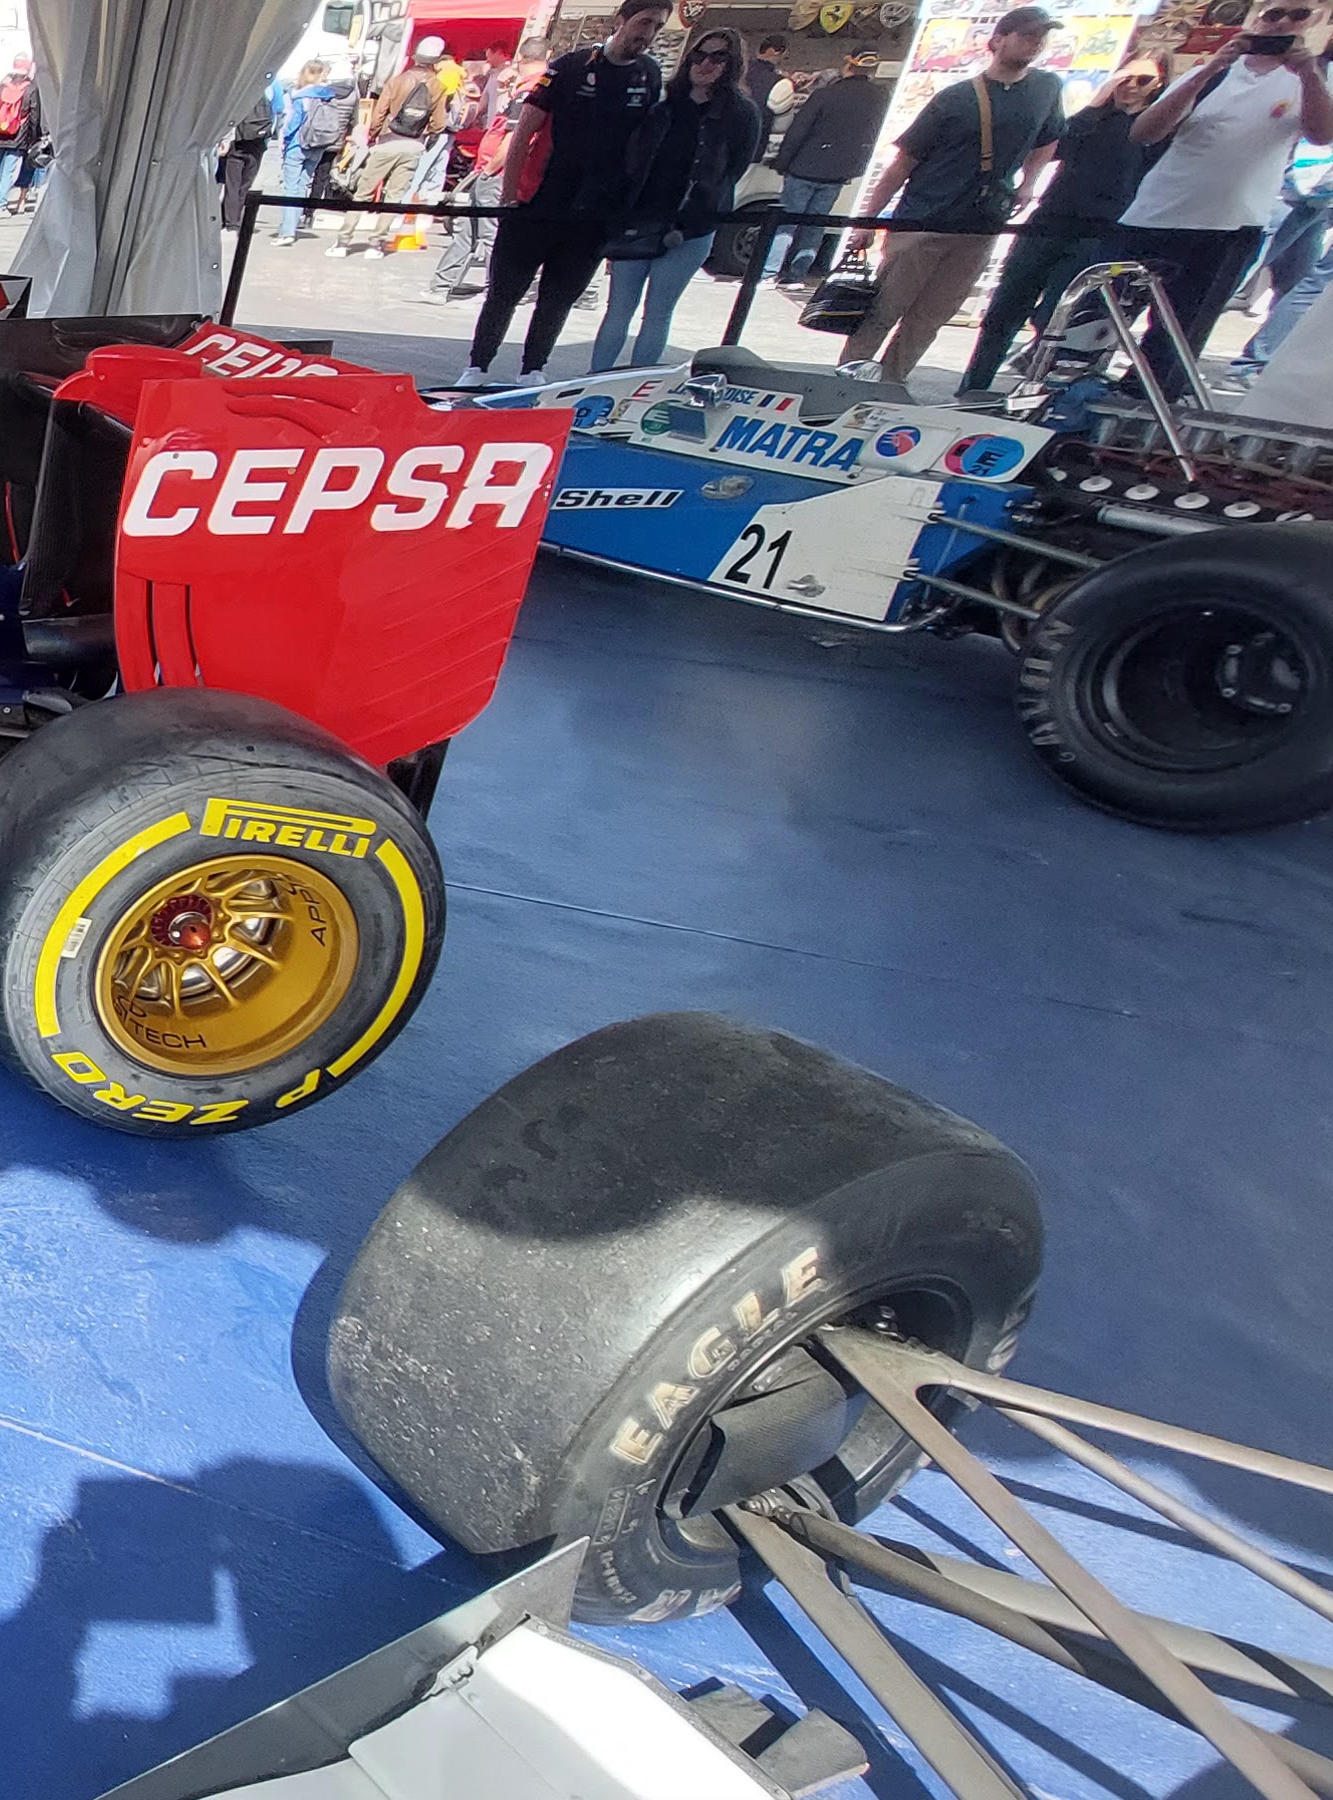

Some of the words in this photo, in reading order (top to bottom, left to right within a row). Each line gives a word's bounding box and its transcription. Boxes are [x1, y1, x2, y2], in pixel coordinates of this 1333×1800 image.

[724, 387, 760, 405] OISE
[714, 414, 865, 472] MATRA
[122, 442, 554, 537] CEPSA
[555, 489, 681, 508] Shell
[724, 523, 793, 590] 21
[198, 797, 378, 859] PIRELLI
[300, 888, 327, 948] APP
[130, 1022, 207, 1050] TECH
[50, 1050, 250, 1126] ZERO
[275, 1068, 322, 1109] P
[611, 1246, 821, 1466] EAGLE
